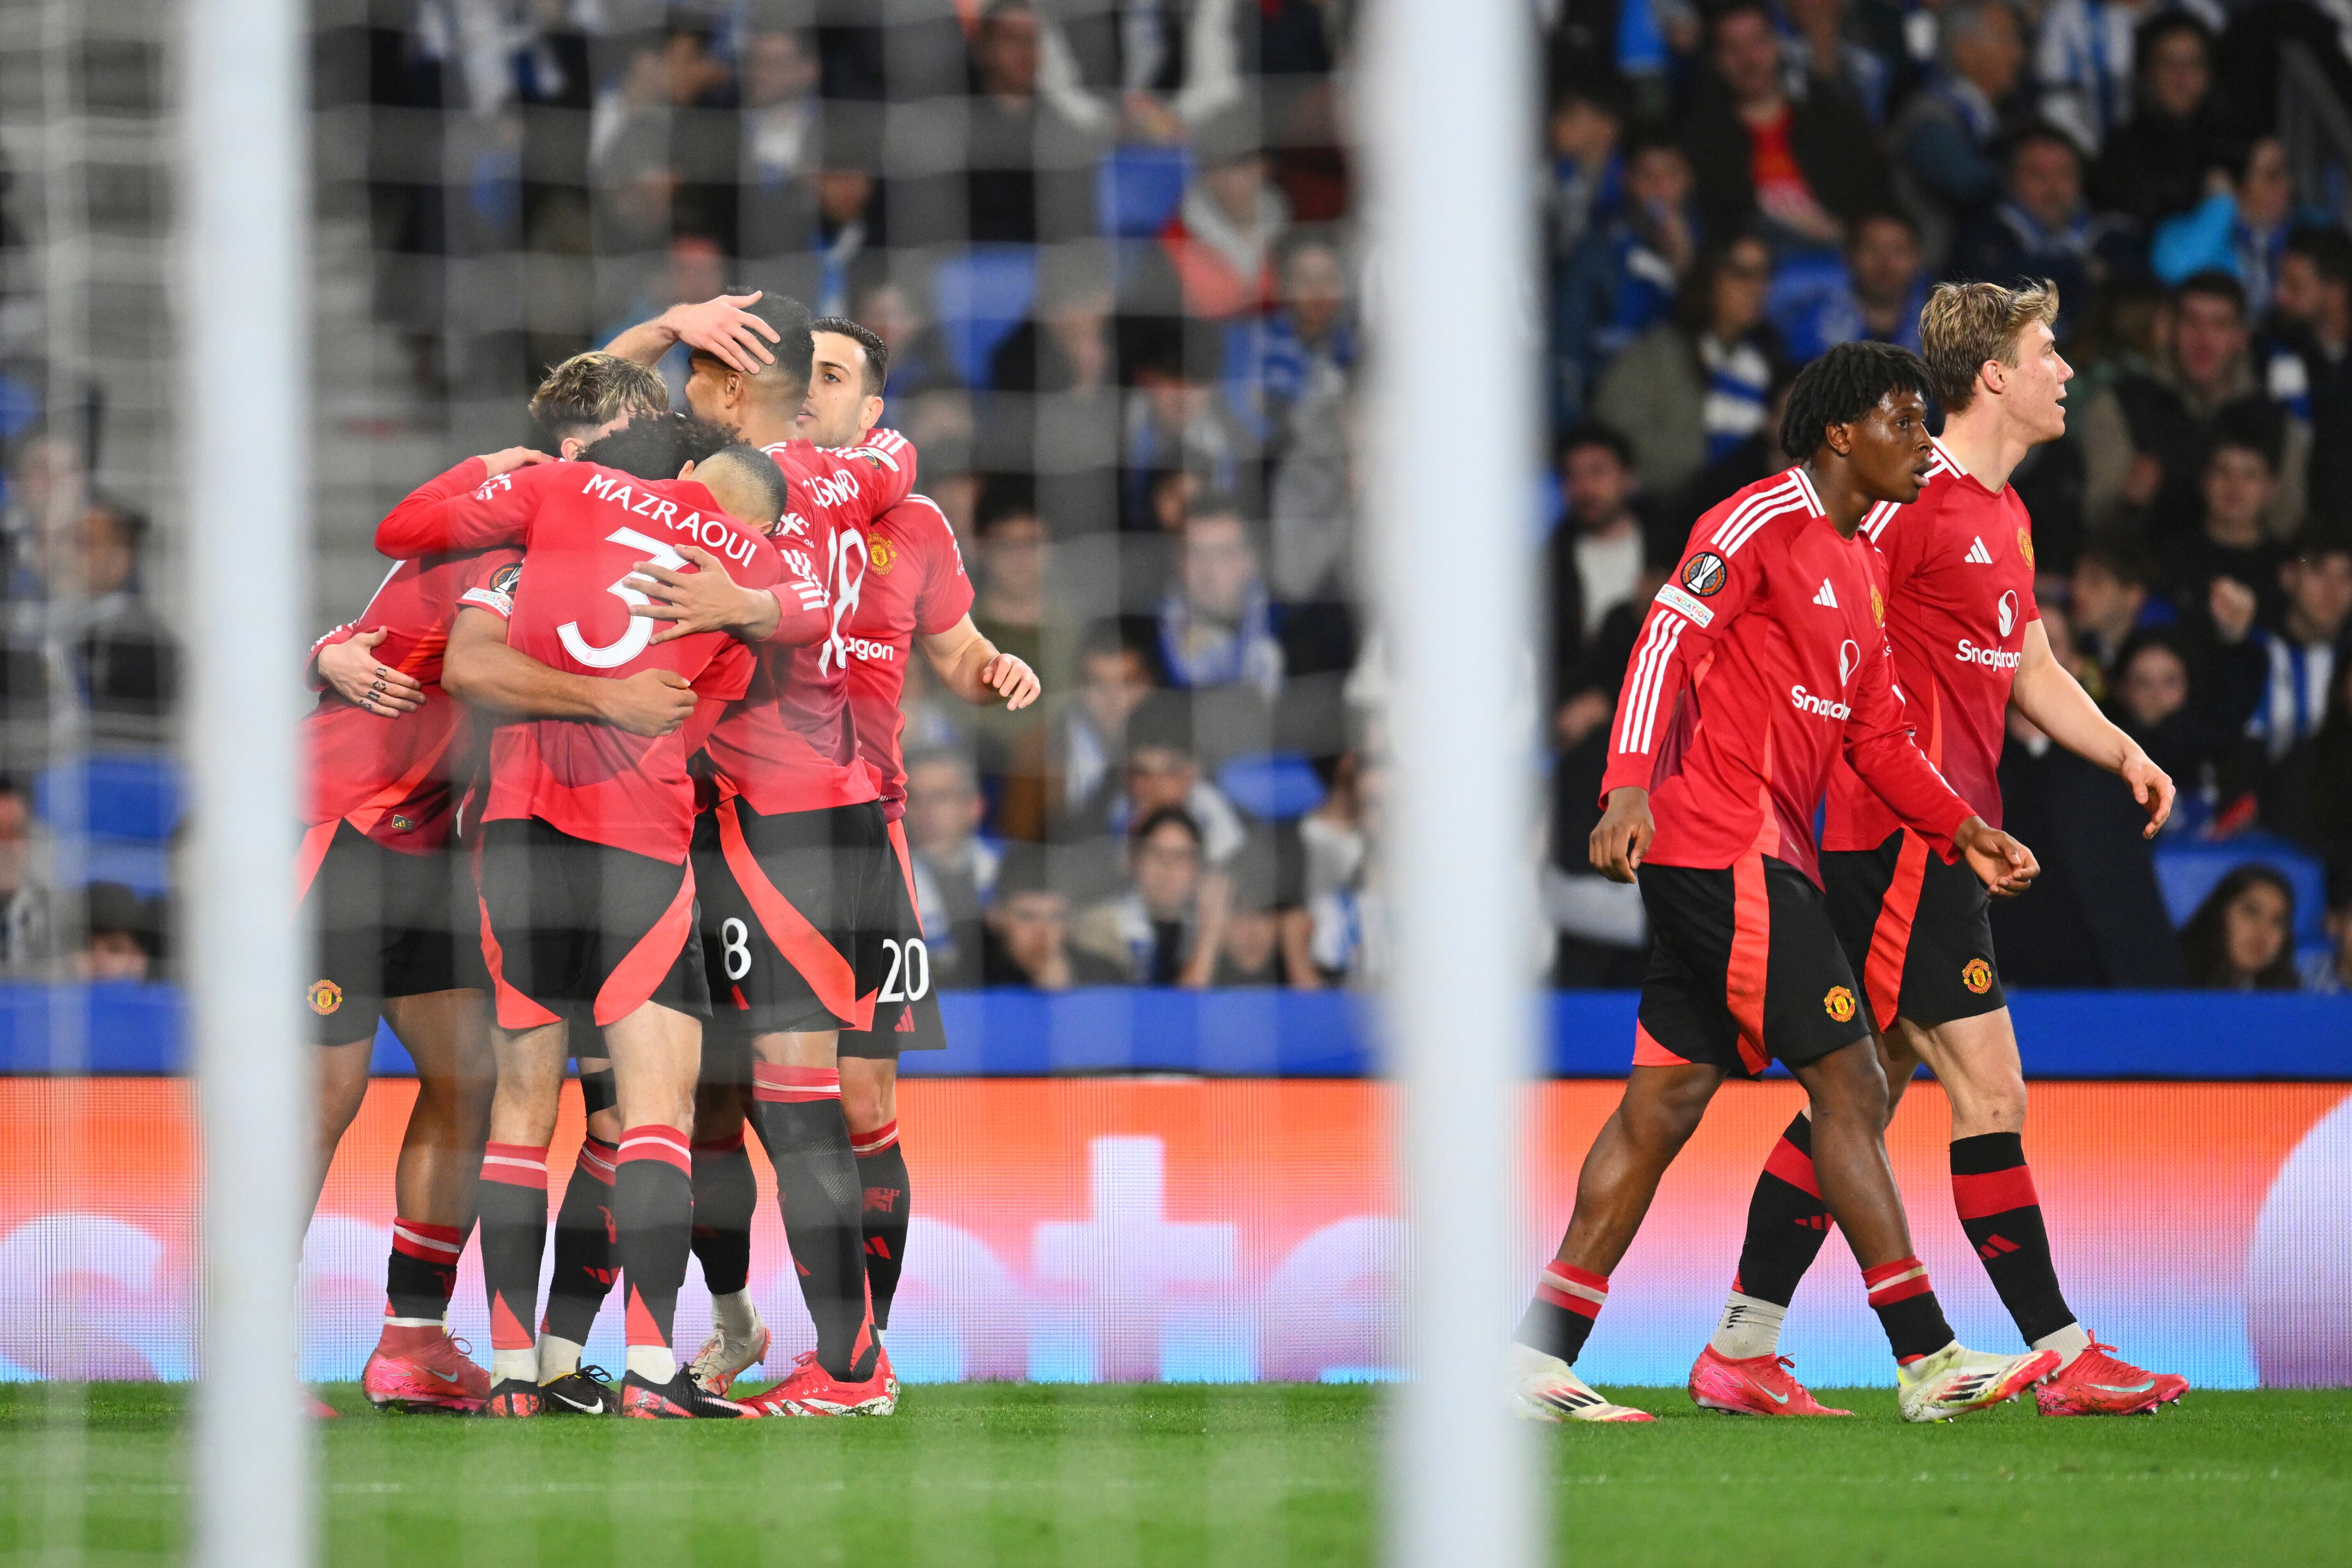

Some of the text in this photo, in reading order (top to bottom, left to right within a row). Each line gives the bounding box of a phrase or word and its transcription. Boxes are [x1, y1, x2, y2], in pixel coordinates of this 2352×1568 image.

[582, 474, 757, 567] MAZRAOUI
[872, 564, 892, 573] UNITED
[557, 526, 691, 668] 3
[1661, 589, 1709, 622] FOUNDATION
[876, 938, 929, 1003] 20
[1965, 961, 1988, 975] MANCHESTER
[1974, 983, 1990, 992] UNITED
